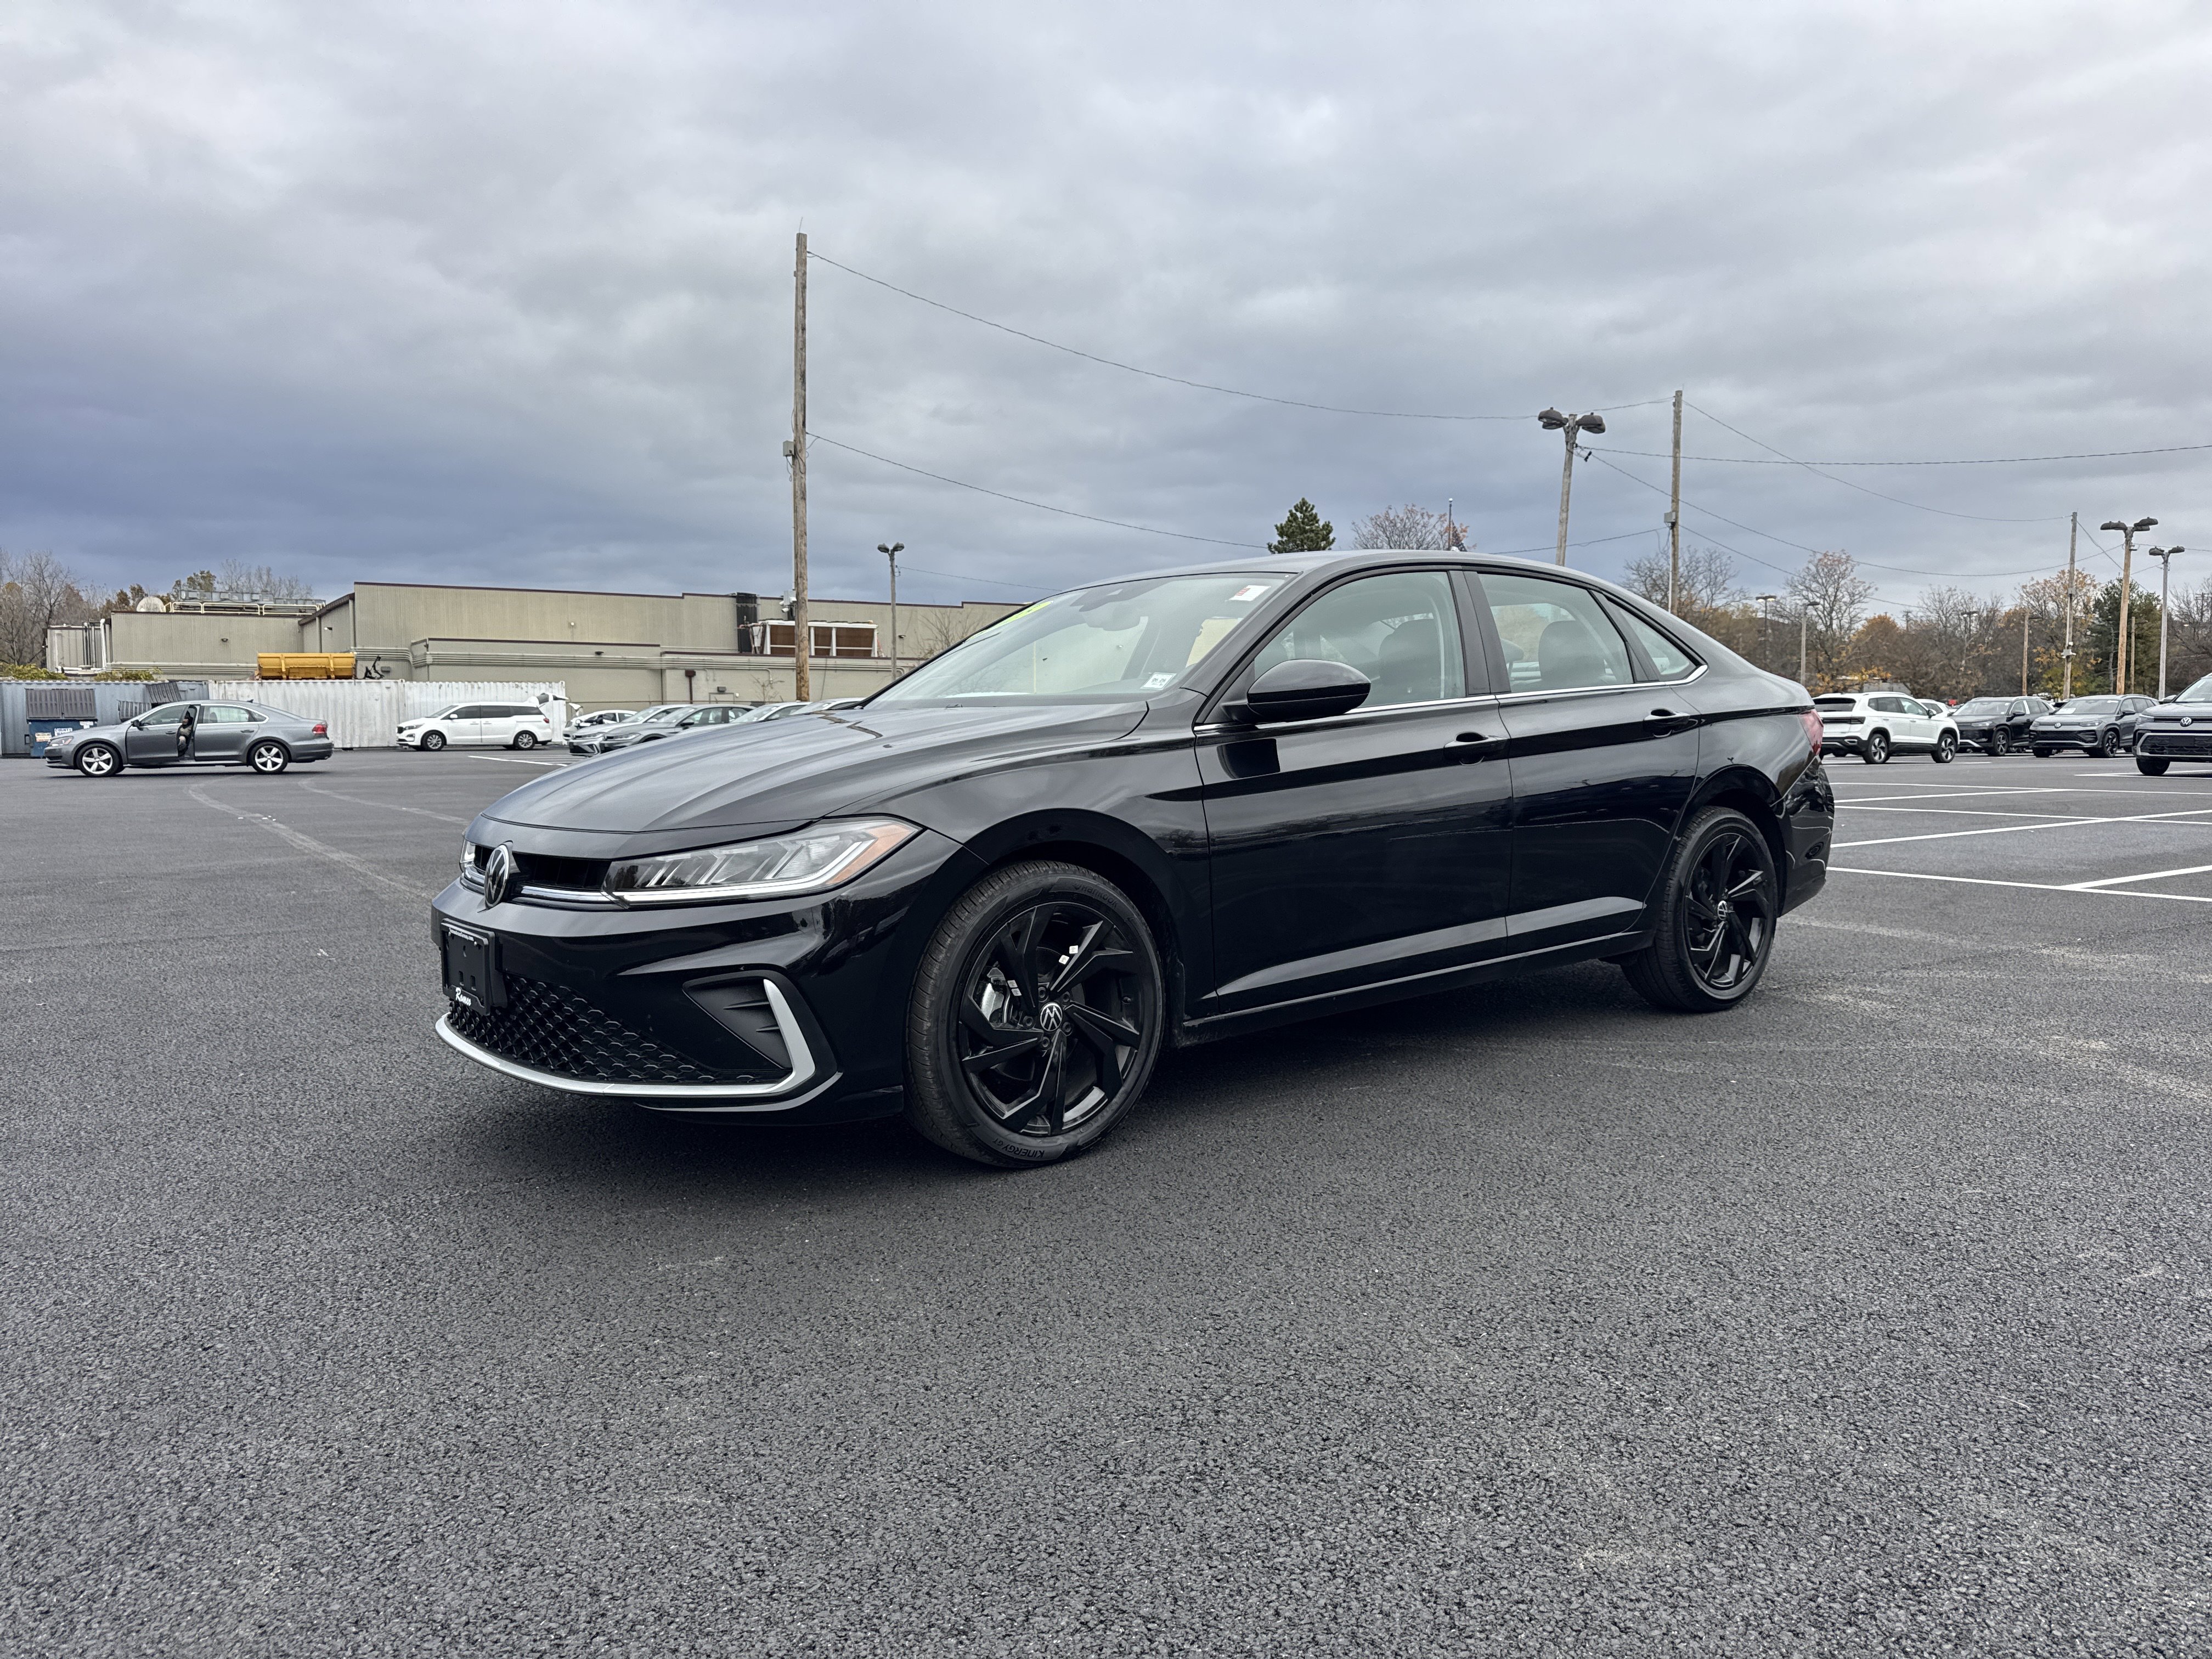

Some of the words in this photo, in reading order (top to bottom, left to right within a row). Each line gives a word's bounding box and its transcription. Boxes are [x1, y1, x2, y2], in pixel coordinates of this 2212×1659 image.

[455, 987, 471, 1006] Romeo
[992, 1138, 1003, 1146] GT
[1002, 1144, 1045, 1158] KINERGY
